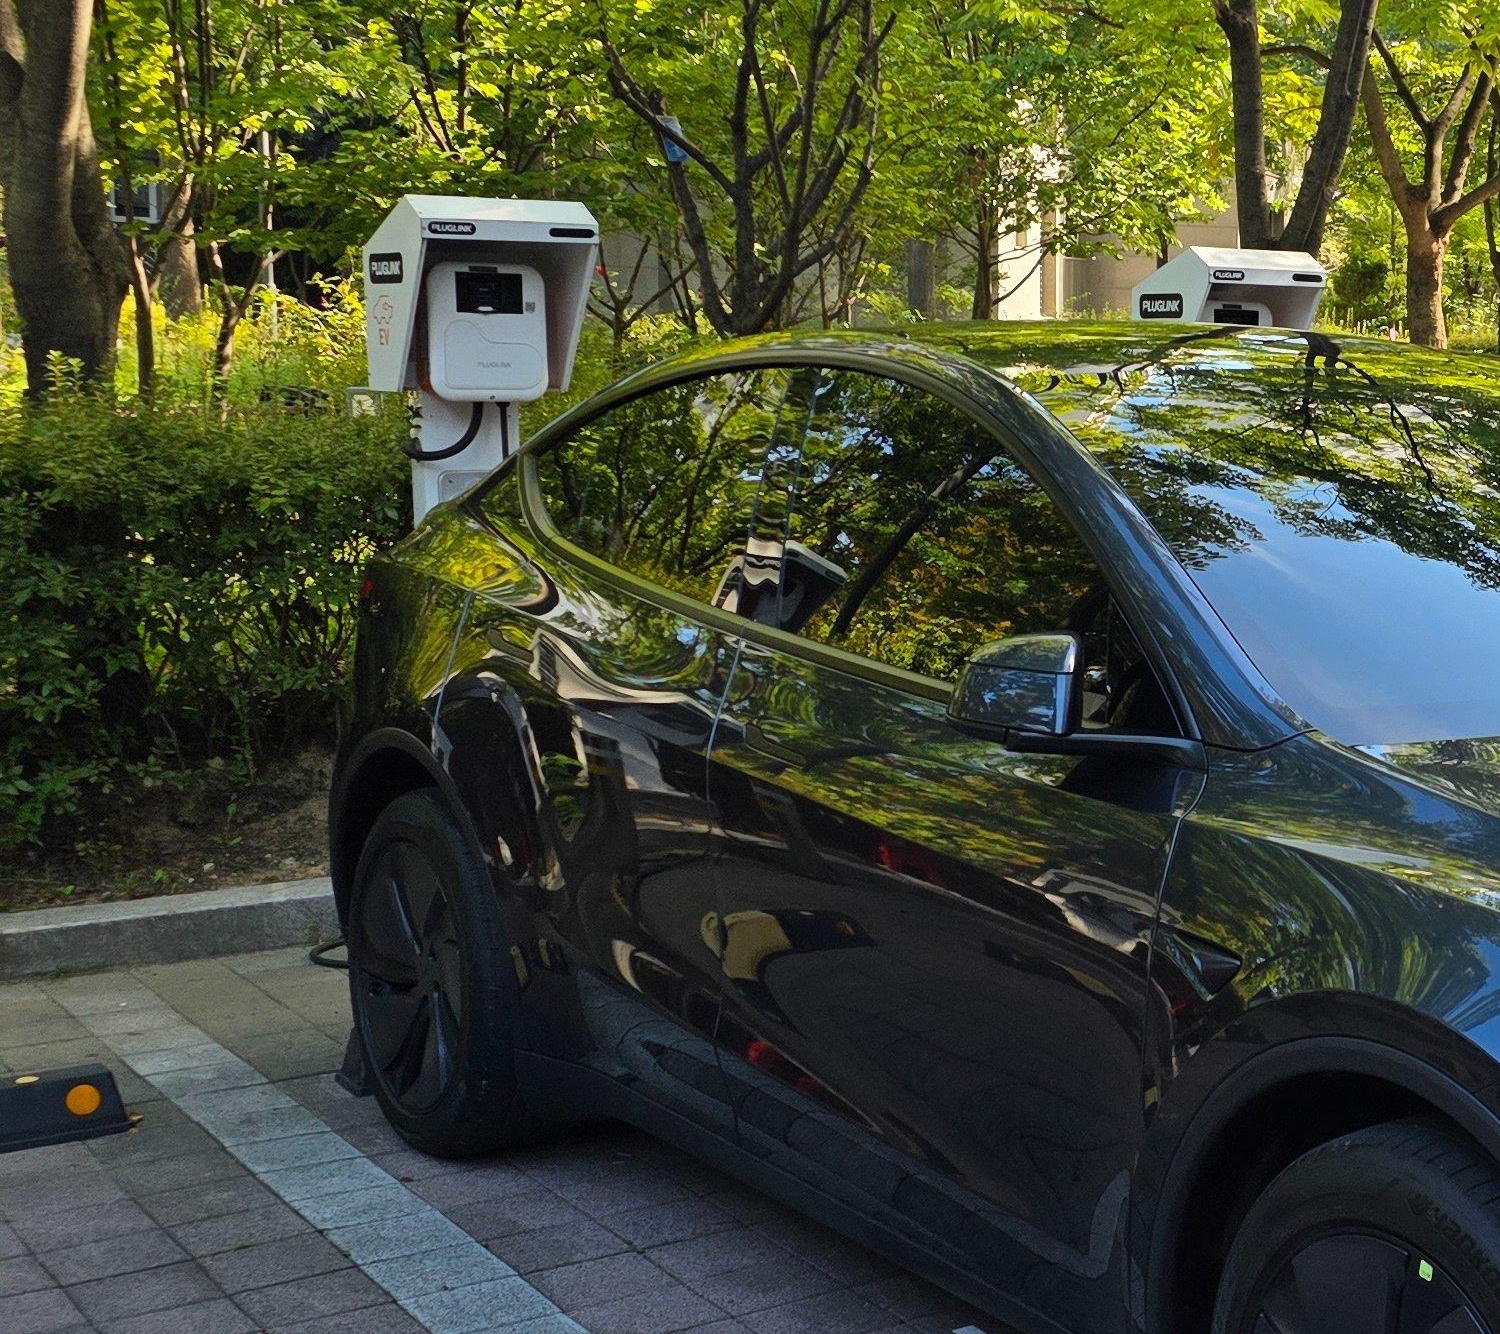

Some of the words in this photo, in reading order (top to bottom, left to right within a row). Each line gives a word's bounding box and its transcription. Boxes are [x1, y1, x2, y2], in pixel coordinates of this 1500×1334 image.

[431, 223, 473, 234] PLUGLINK
[1142, 299, 1180, 313] PLUGLINK
[378, 328, 389, 345] EV
